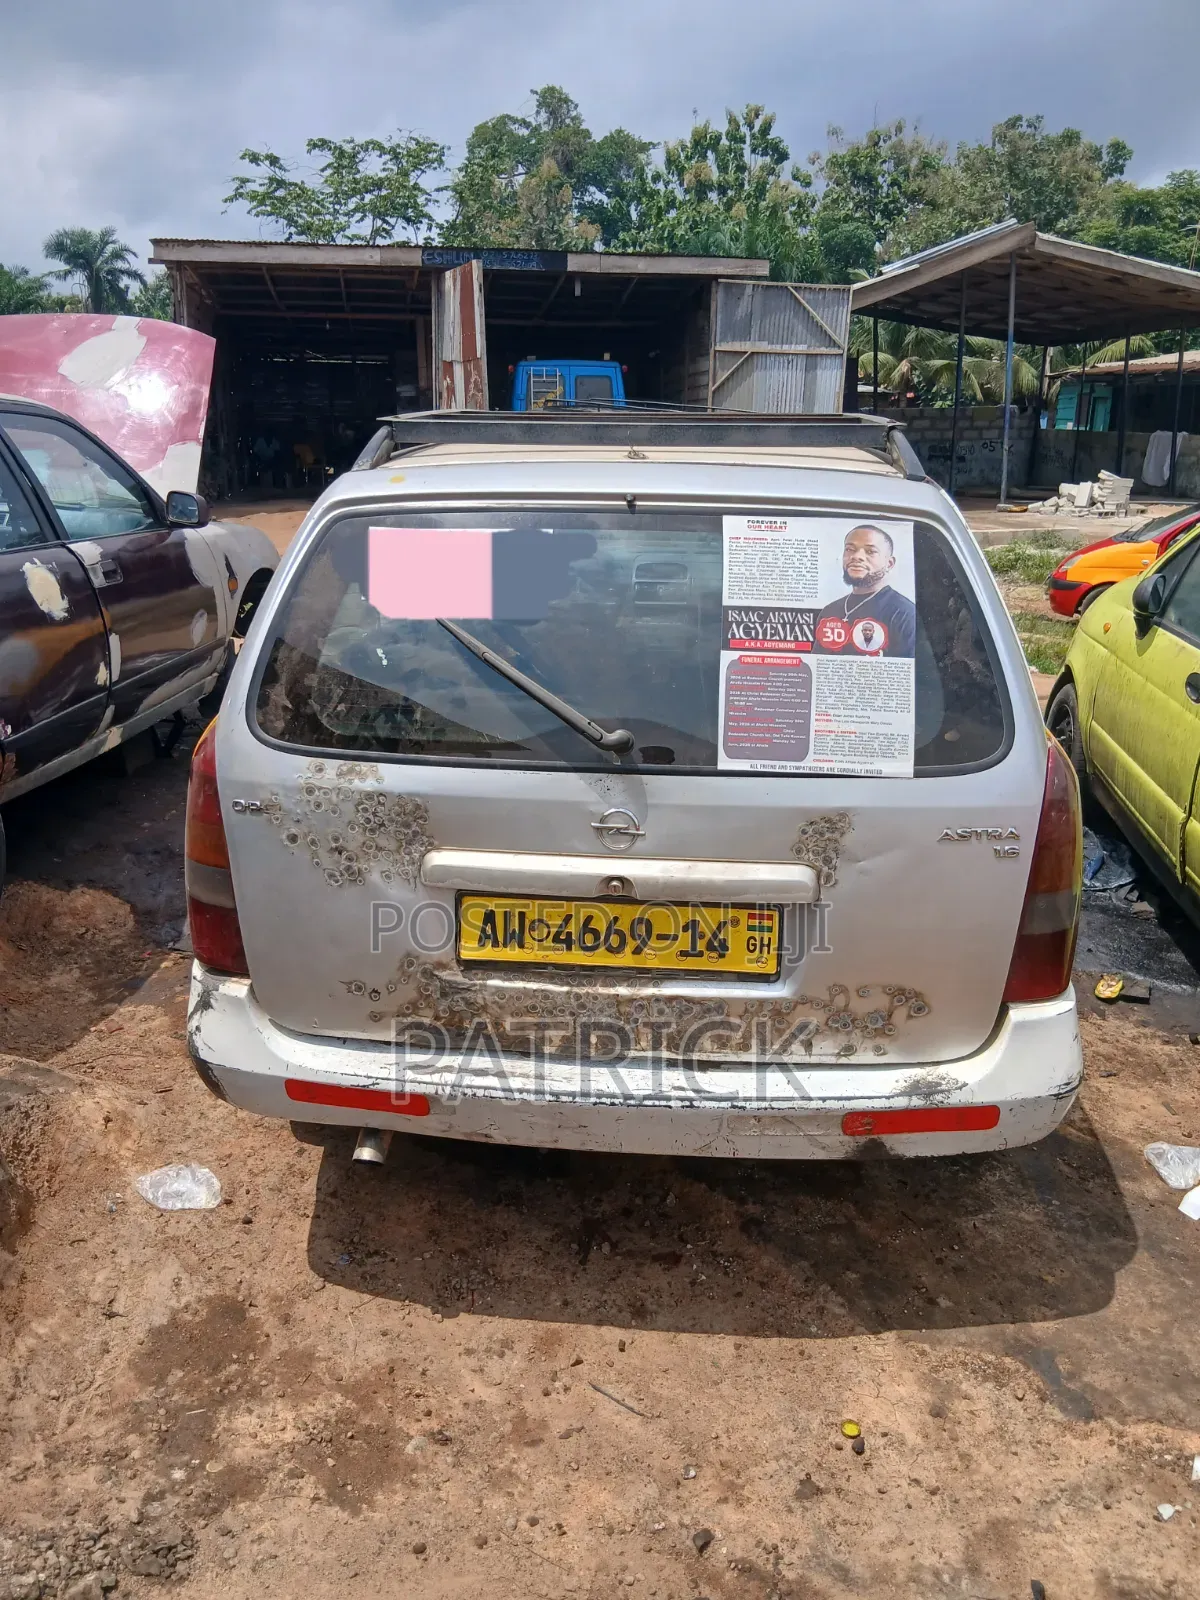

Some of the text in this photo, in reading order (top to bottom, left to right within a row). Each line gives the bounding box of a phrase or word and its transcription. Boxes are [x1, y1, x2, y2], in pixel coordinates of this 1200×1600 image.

[728, 610, 814, 624] ISAAC AKWASI
[727, 622, 814, 642] AGYEMAN
[822, 628, 845, 642] 30
[937, 826, 1020, 842] ASTRA
[478, 908, 730, 959] AW 4669-14
[746, 935, 772, 955] GH
